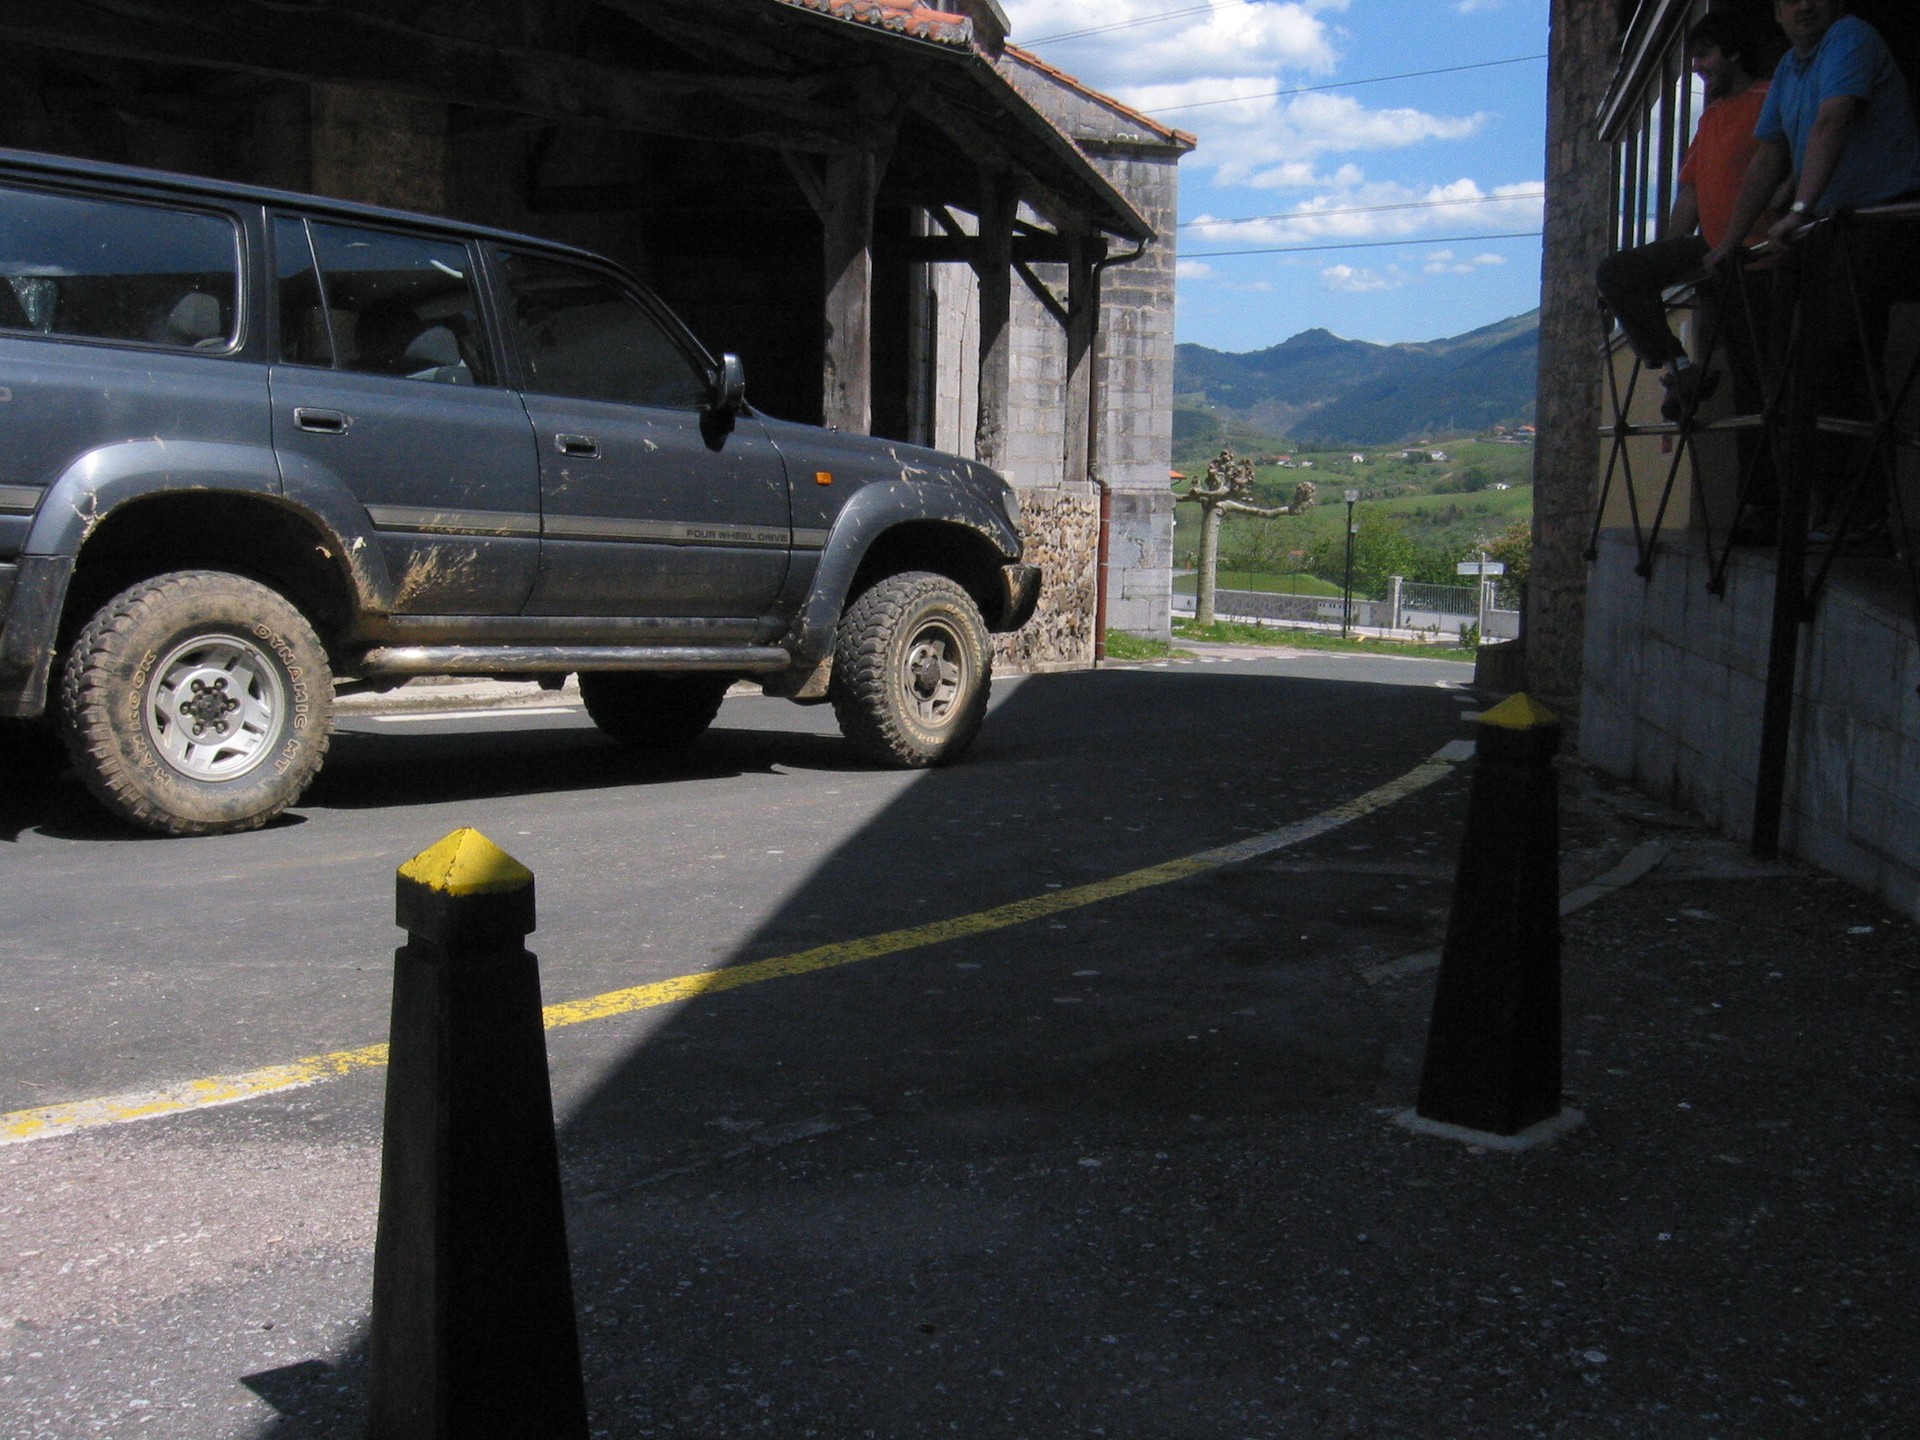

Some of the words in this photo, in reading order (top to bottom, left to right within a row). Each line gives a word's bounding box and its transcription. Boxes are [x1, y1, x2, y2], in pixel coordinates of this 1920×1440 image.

[686, 529, 716, 539] FOUR
[718, 530, 756, 541] WHEEL
[757, 534, 788, 542] DRIVE
[252, 623, 310, 730] DYNAMIC
[126, 648, 173, 786] HANKOOK
[273, 738, 302, 776] MT
